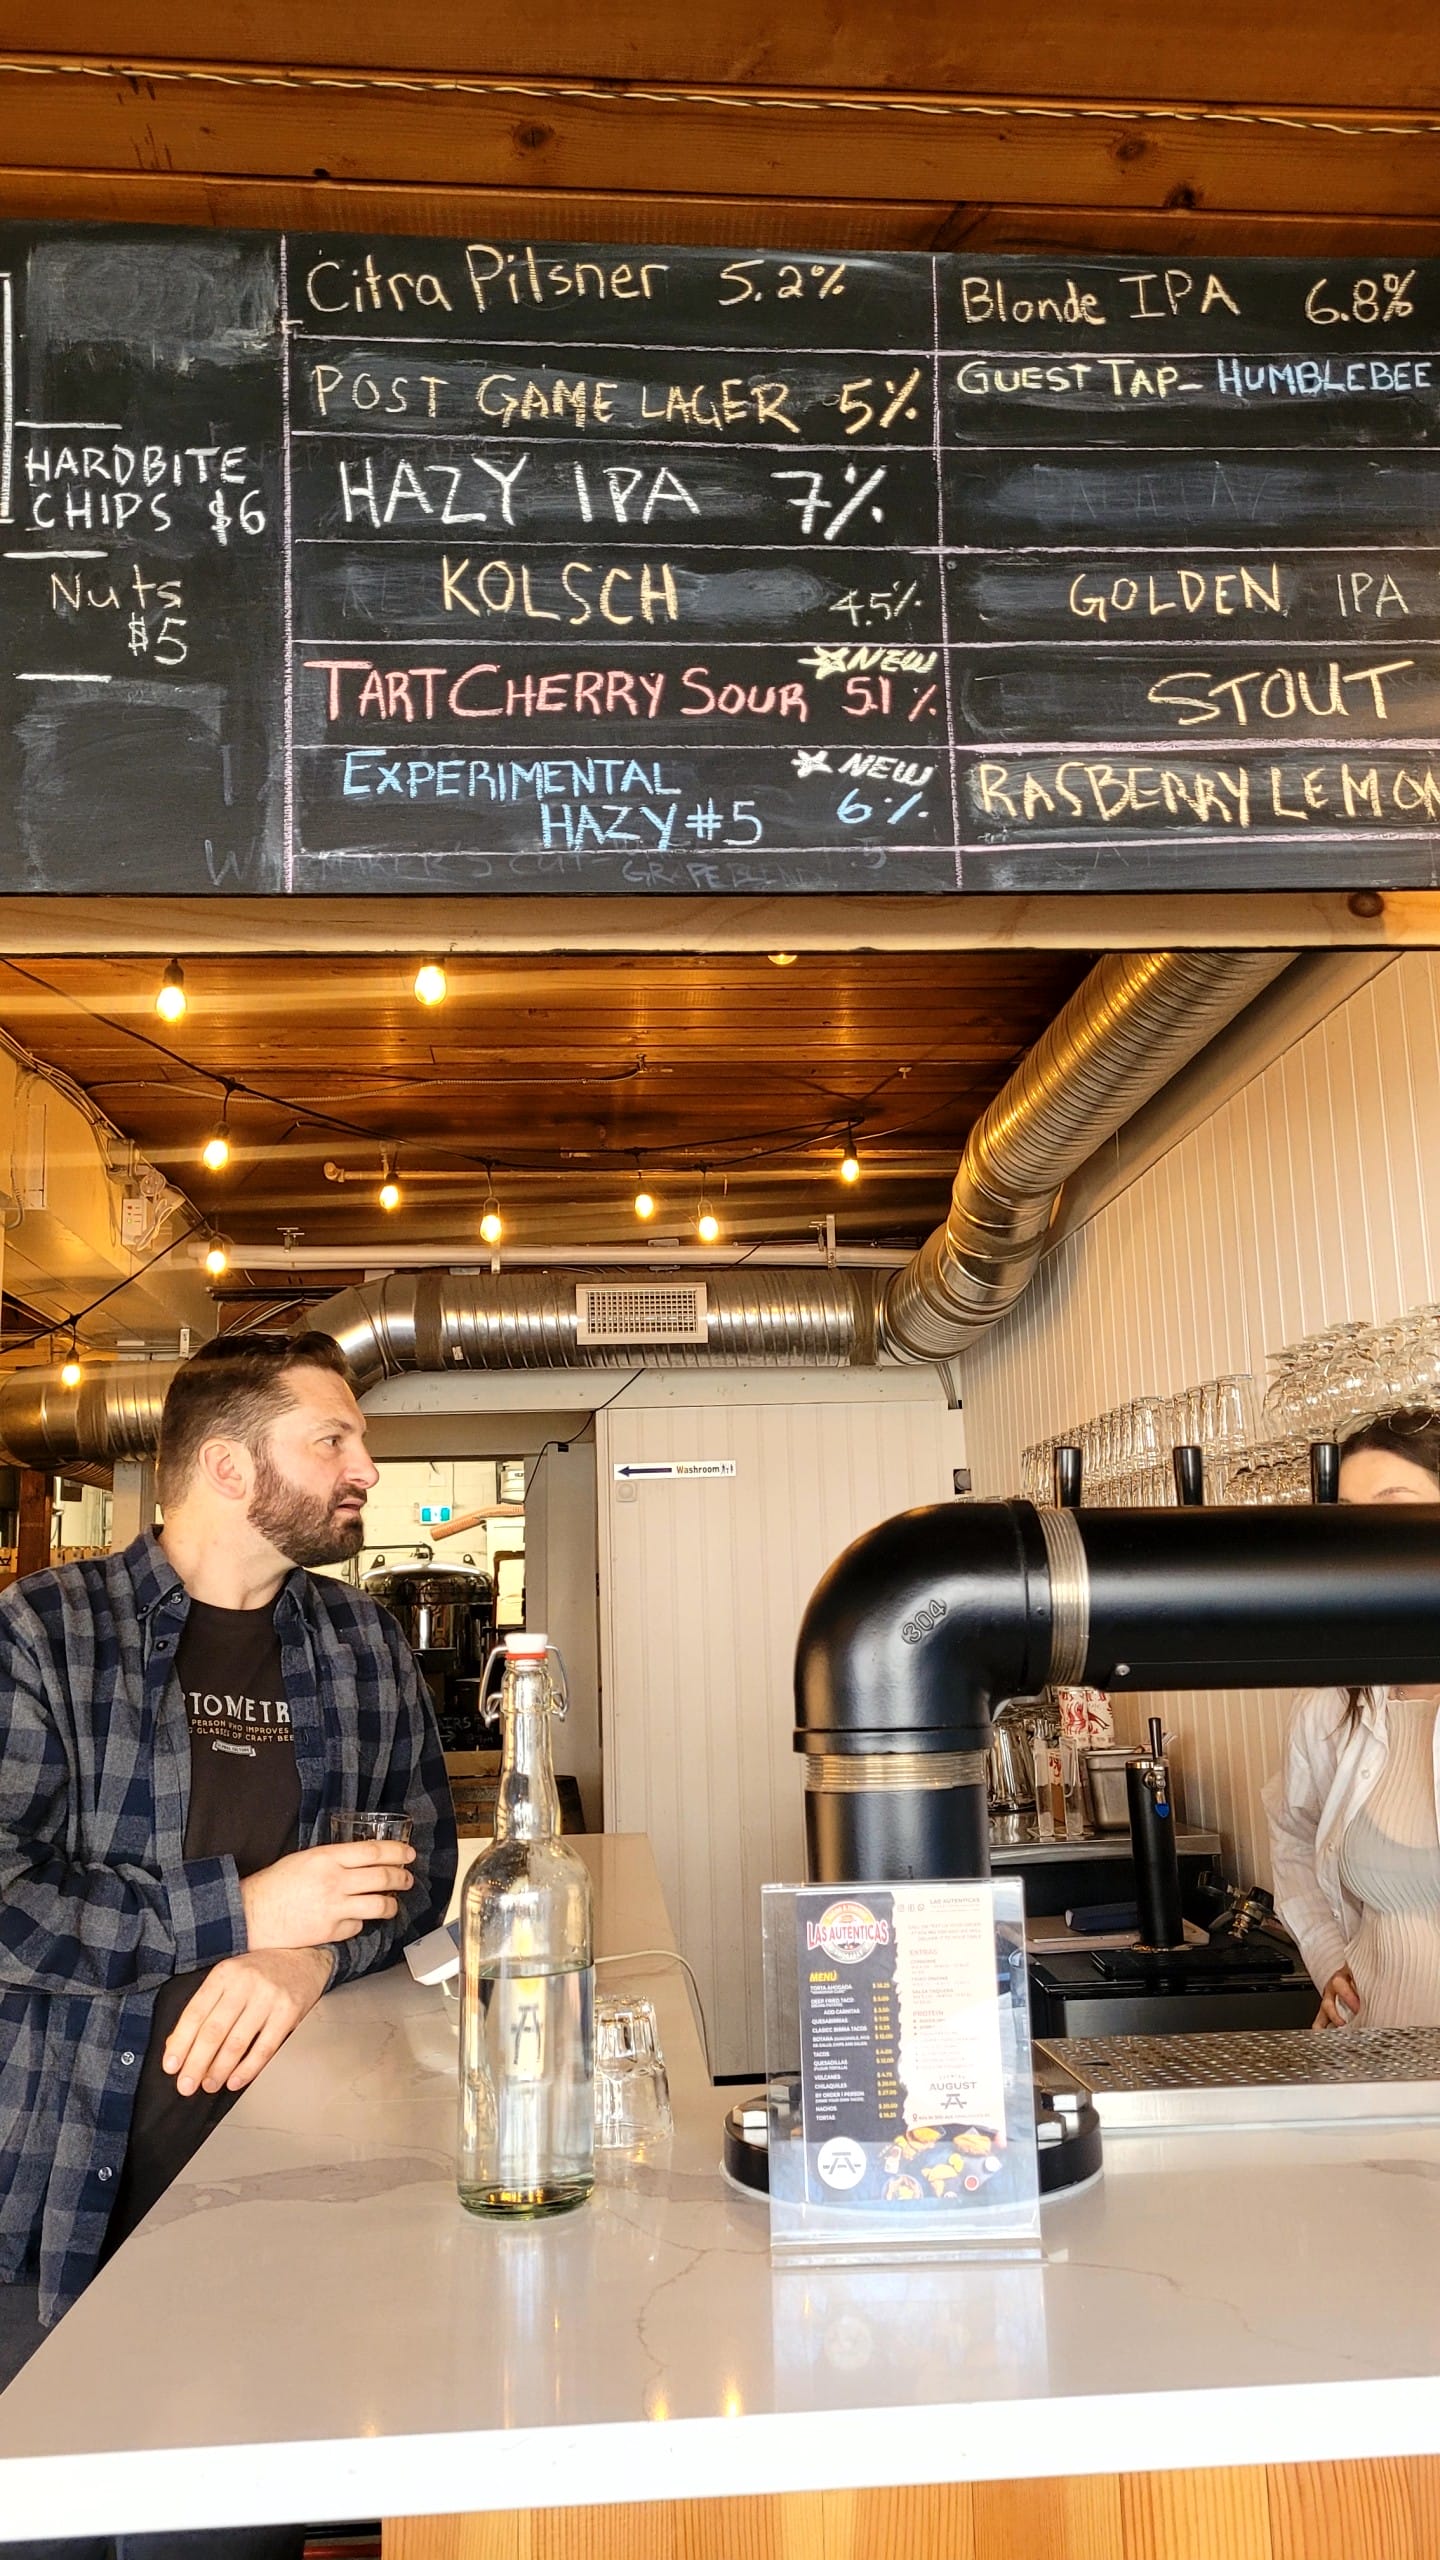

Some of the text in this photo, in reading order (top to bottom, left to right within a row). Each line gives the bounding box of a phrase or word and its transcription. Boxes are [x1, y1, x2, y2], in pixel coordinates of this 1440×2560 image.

[306, 255, 452, 314] Citra
[465, 242, 670, 314] Pilsner
[959, 268, 1418, 326] Blonde IPA 6.8%
[312, 364, 922, 436] POST GAME LAGER 5%
[957, 356, 1092, 396] GUEST
[1217, 356, 1433, 398] HUMBLEBEE
[24, 444, 248, 490] HARDBITE
[28, 488, 267, 547] CHIPS $6
[338, 452, 888, 542] HAZY IPA 7%
[50, 562, 184, 612] Nuts
[441, 552, 680, 624] KOLSCH
[1068, 560, 1410, 622] GOLDEN IPA
[126, 610, 188, 666] $5
[846, 646, 938, 676] NEW
[303, 658, 449, 724] TART
[450, 660, 664, 720] CHERRY
[1147, 658, 1416, 728] STOUT
[342, 748, 682, 800] EXPERIMENTAL
[838, 752, 934, 786] NEW
[540, 788, 930, 852] HAZY #5 6%
[676, 1465, 720, 1474] Washroom
[902, 1600, 946, 1643] 304
[183, 1692, 291, 1723] TOMETR
[191, 1719, 226, 1727] PERSON
[245, 1726, 289, 1735] IMPROVES
[245, 1734, 273, 1743] CRAFT
[806, 1919, 889, 1951] LAS AUTENTICAS
[929, 2081, 977, 2091] AUGUST
